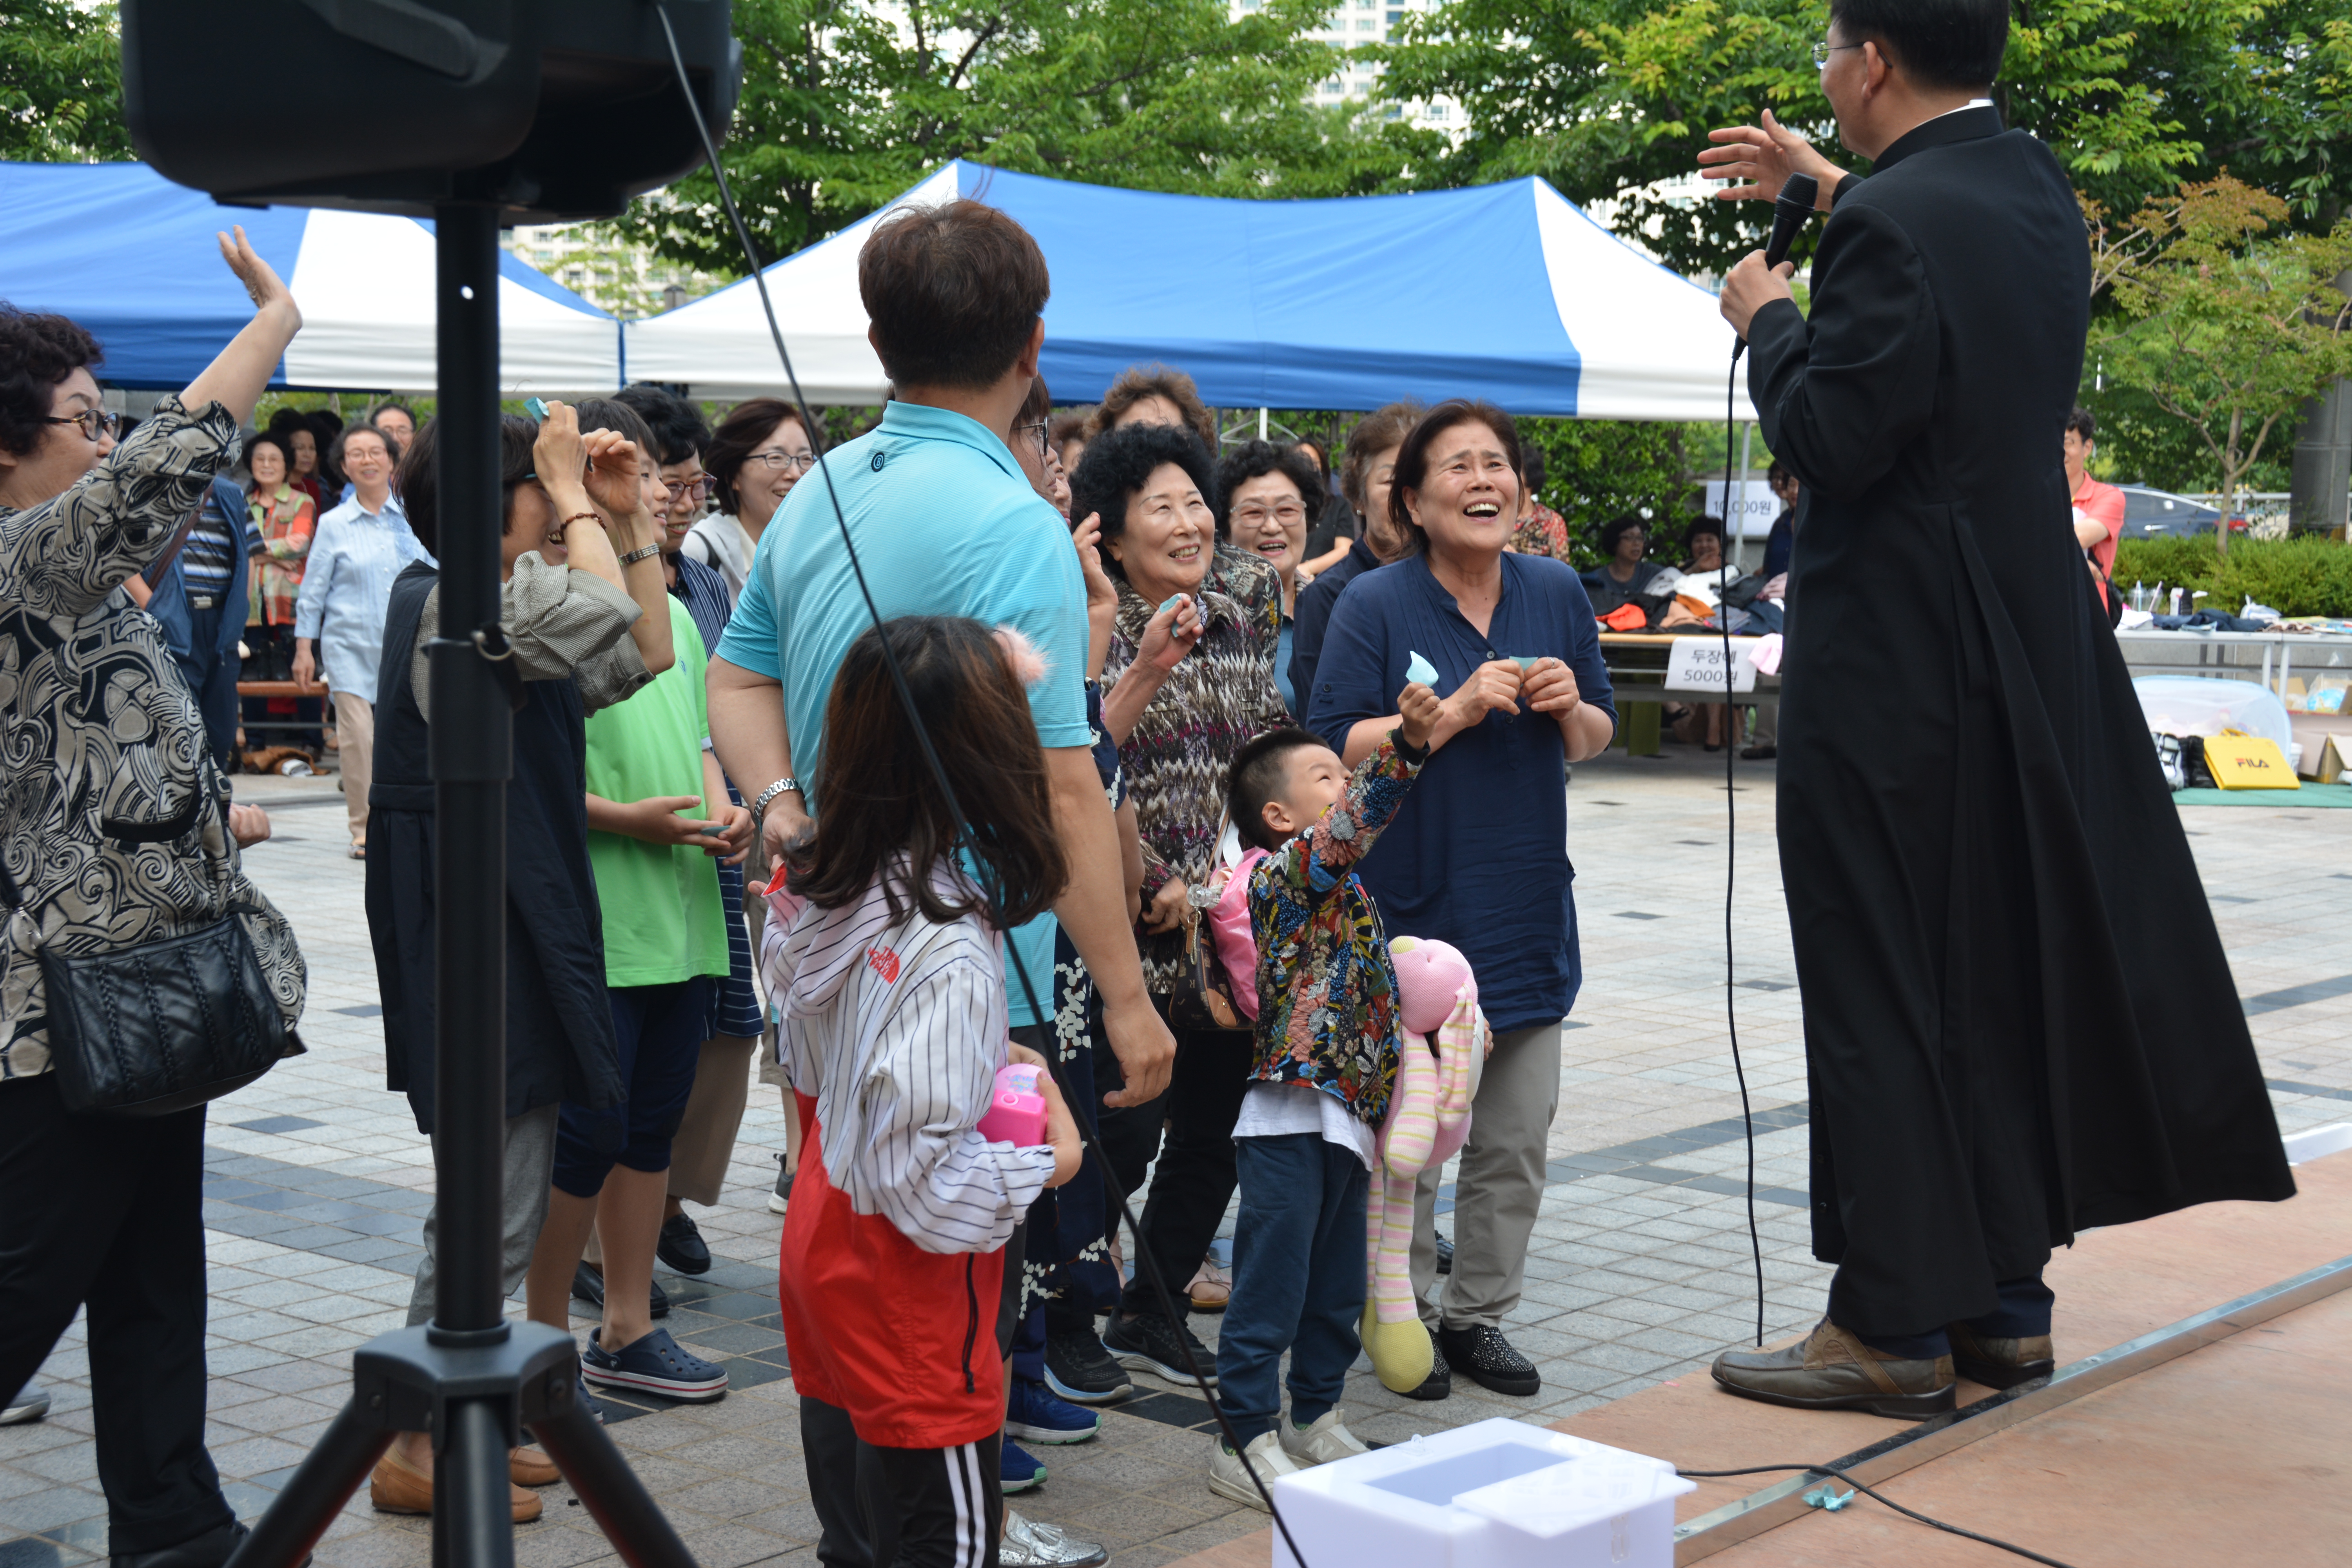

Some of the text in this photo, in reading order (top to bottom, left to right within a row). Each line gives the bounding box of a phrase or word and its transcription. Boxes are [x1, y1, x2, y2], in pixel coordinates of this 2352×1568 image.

[876, 457, 881, 466] B
[2236, 758, 2269, 768] FILA
[1306, 1437, 1336, 1462] N
